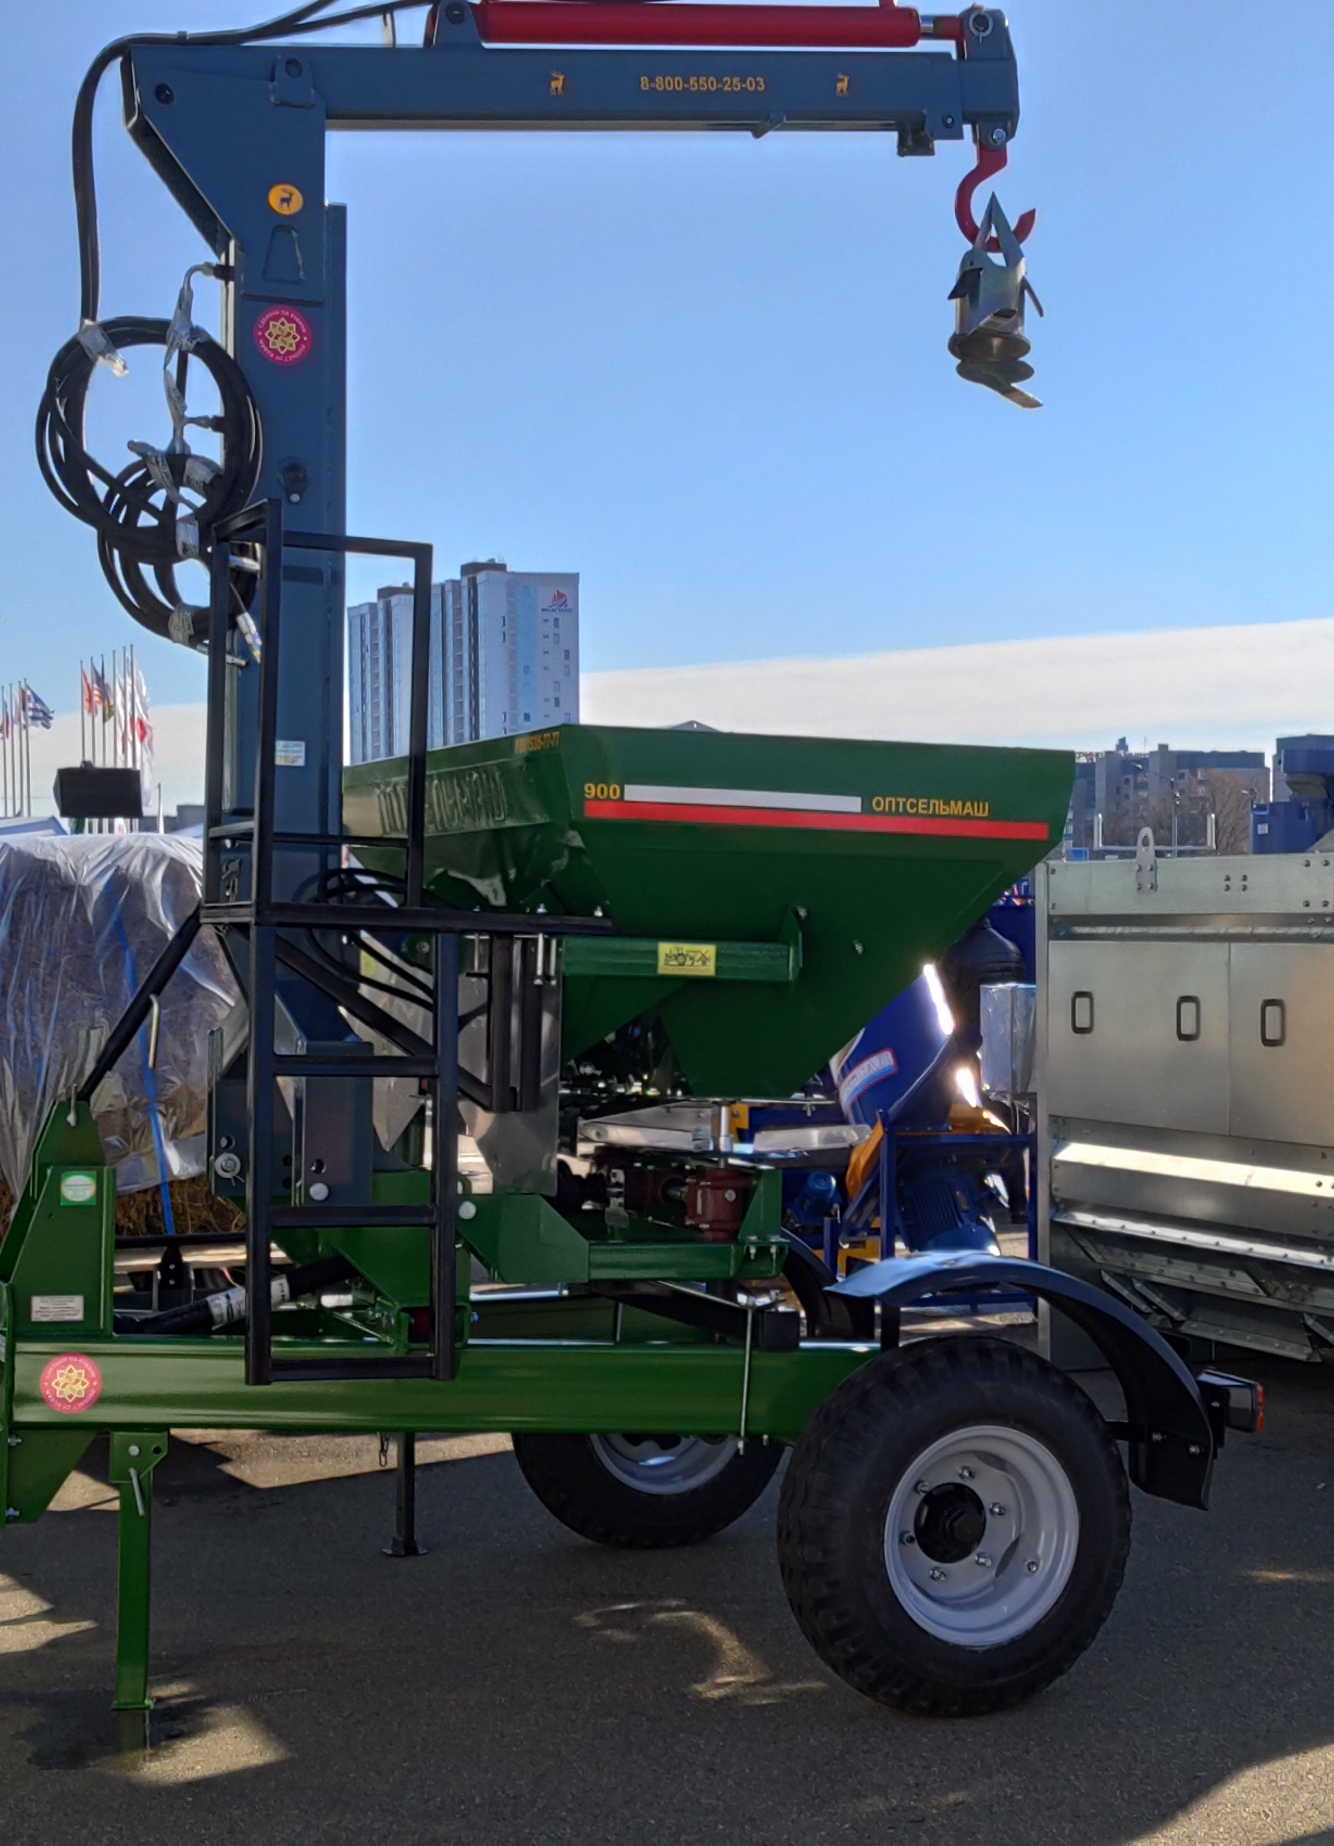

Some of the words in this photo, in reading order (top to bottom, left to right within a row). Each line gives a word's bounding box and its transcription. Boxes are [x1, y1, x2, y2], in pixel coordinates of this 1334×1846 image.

[640, 75, 765, 91] 8-800-550-25-03
[584, 784, 621, 800] 900
[871, 795, 990, 818] ОПТСЕЛЬМАШ
